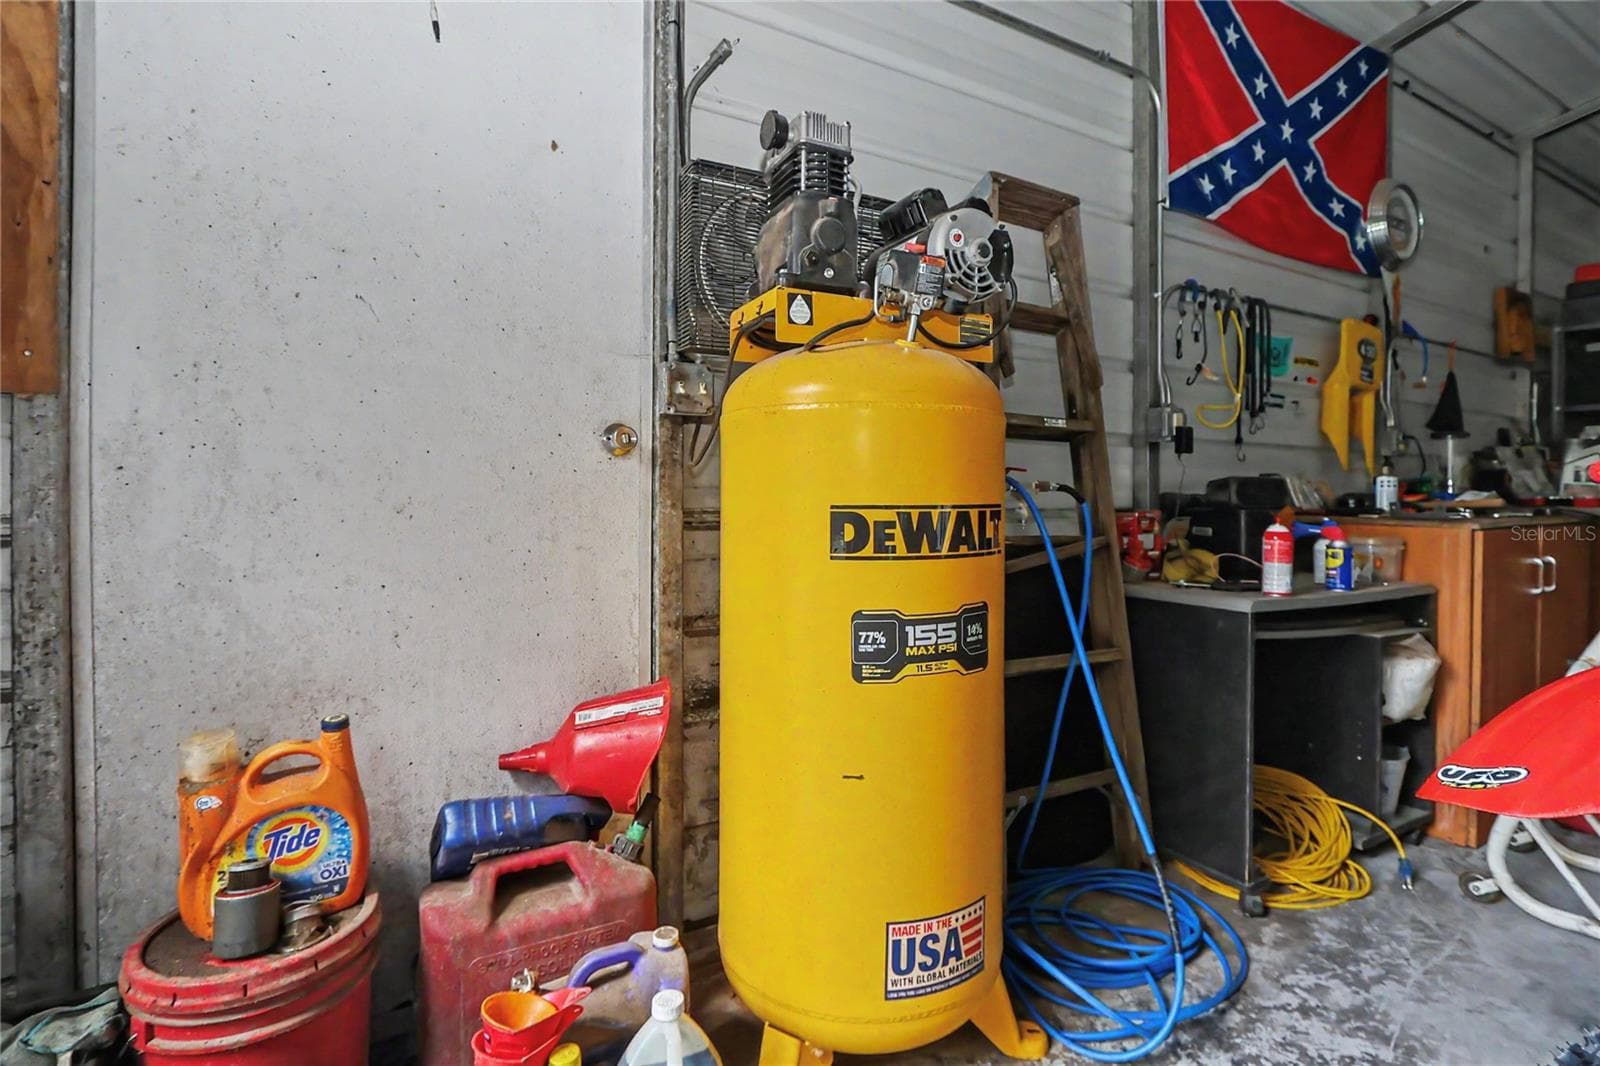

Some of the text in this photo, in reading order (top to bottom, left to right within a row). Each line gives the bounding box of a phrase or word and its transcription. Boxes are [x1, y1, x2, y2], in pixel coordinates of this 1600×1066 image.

[830, 510, 1001, 554] DEWALT
[858, 631, 886, 644] 77%
[905, 622, 957, 647] 155
[966, 622, 982, 636] 14%
[905, 645, 936, 657] MAX
[938, 642, 957, 654] PSI
[916, 664, 933, 673] 11.5
[263, 821, 321, 861] Tide
[320, 864, 347, 880] OXI
[891, 916, 953, 938] MADE IN THE
[891, 926, 963, 976] USA
[890, 950, 983, 988] WITH GLOBAL MATERIALS
